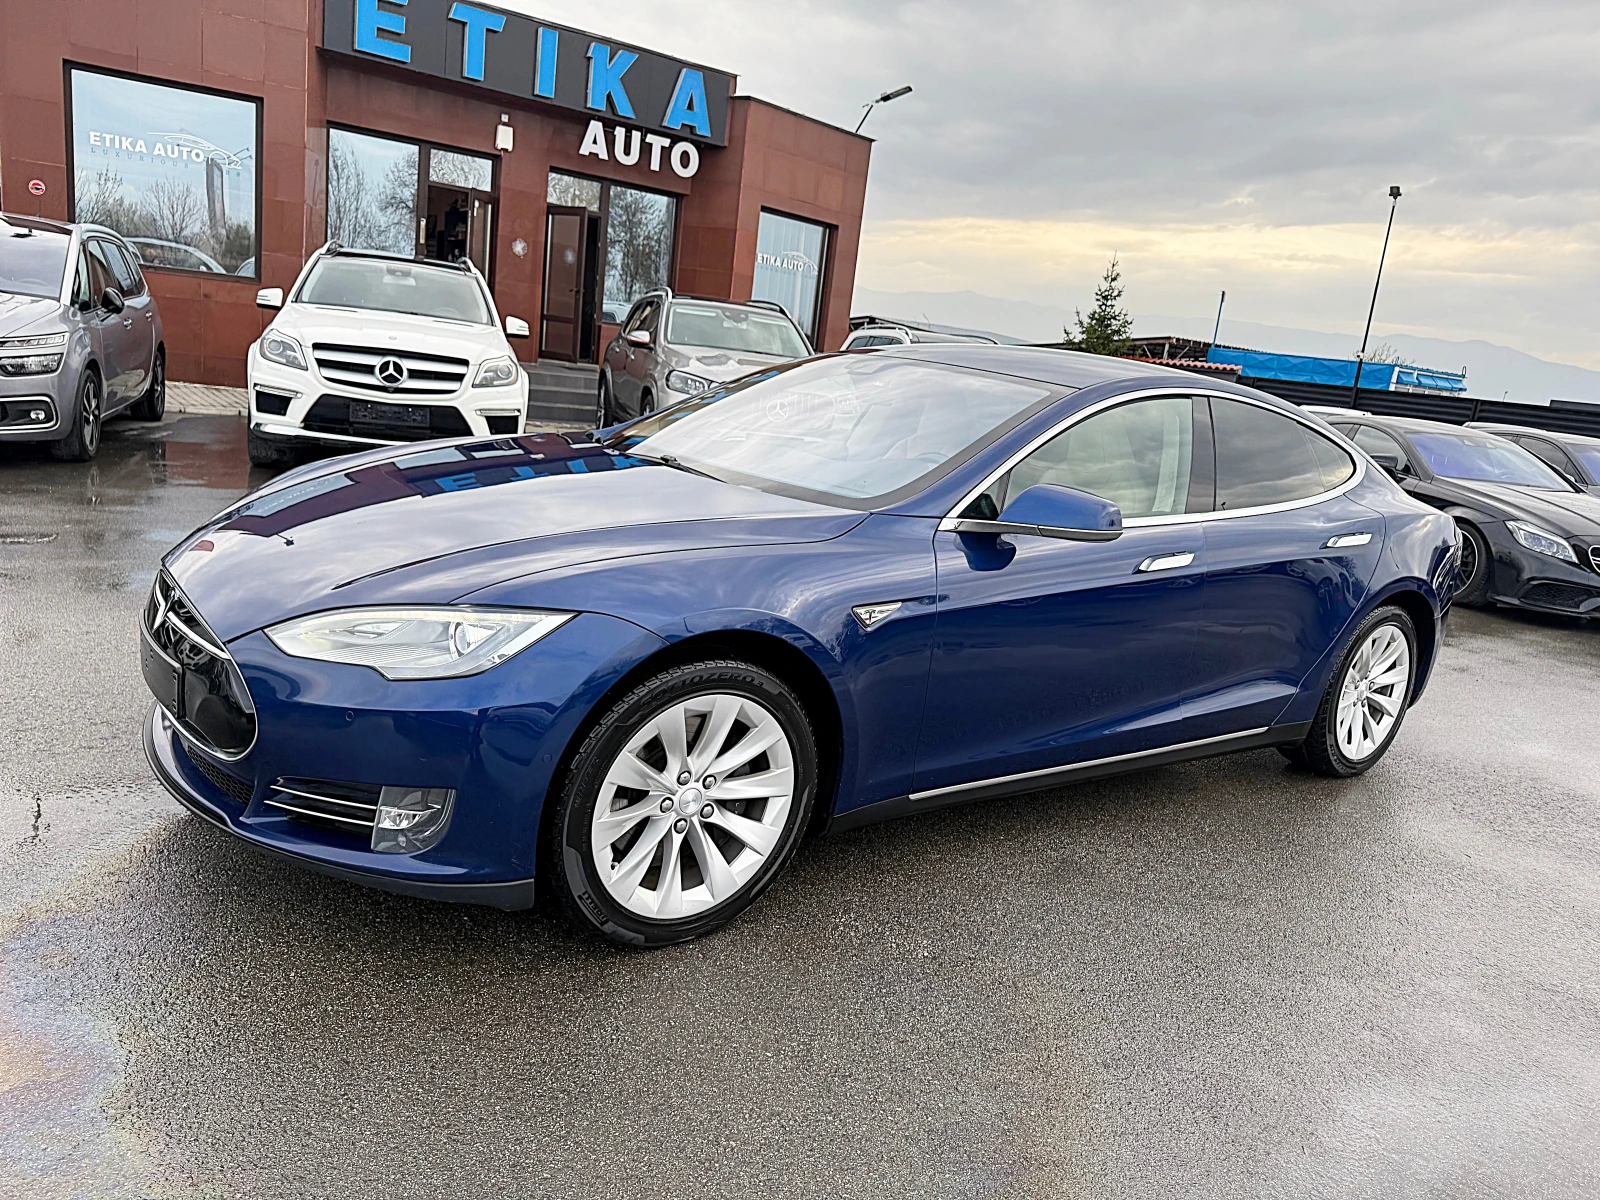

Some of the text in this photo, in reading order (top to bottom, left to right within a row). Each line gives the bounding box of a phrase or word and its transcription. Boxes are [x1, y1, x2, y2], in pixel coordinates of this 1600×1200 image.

[353, 0, 711, 138] ETIKA
[89, 131, 205, 163] ETIKA AUTO
[91, 147, 188, 169] LUXURIOUS
[579, 120, 700, 178] AUTO
[757, 253, 781, 267] ETIKA
[782, 258, 804, 272] AUTO
[640, 671, 756, 706] SOTTOZERO
[577, 891, 609, 926] PIRELLI
